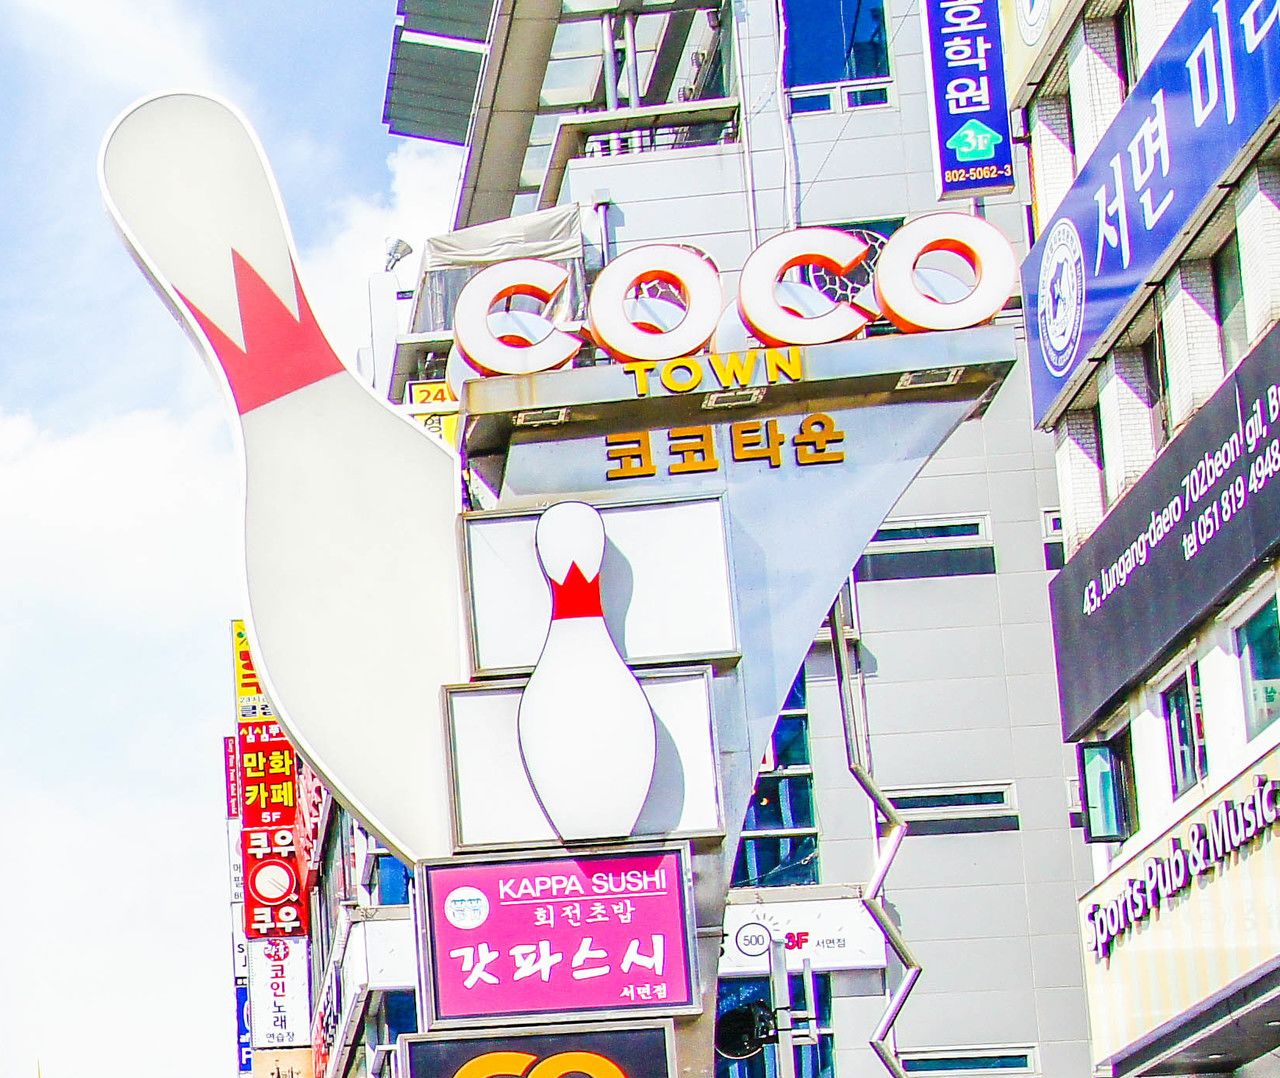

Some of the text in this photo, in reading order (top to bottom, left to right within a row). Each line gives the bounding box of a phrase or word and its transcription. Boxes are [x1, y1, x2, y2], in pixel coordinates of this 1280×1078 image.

[961, 131, 991, 152] 3F
[1093, 89, 1174, 277] 서면
[455, 212, 1019, 377] COCO
[624, 347, 803, 397] TOWN
[606, 414, 845, 480] 코코타운
[1182, 434, 1240, 514] 702beon
[1245, 398, 1268, 451] gil,
[1182, 441, 1280, 561] tel 051 819 4948
[243, 750, 293, 778] 만화
[245, 781, 294, 808] 카페
[261, 811, 281, 823] 5F
[247, 830, 295, 859] 쿠우
[499, 868, 668, 900] KAPPA SUSHI
[1086, 878, 1146, 960] Sports
[1145, 837, 1187, 912] Pub
[1187, 821, 1209, 870] &
[251, 906, 300, 934] 쿠우
[533, 902, 636, 929] 회전초밥
[743, 931, 809, 950] 500 3F
[815, 936, 847, 949] 서면점
[619, 982, 668, 1001] 서면점
